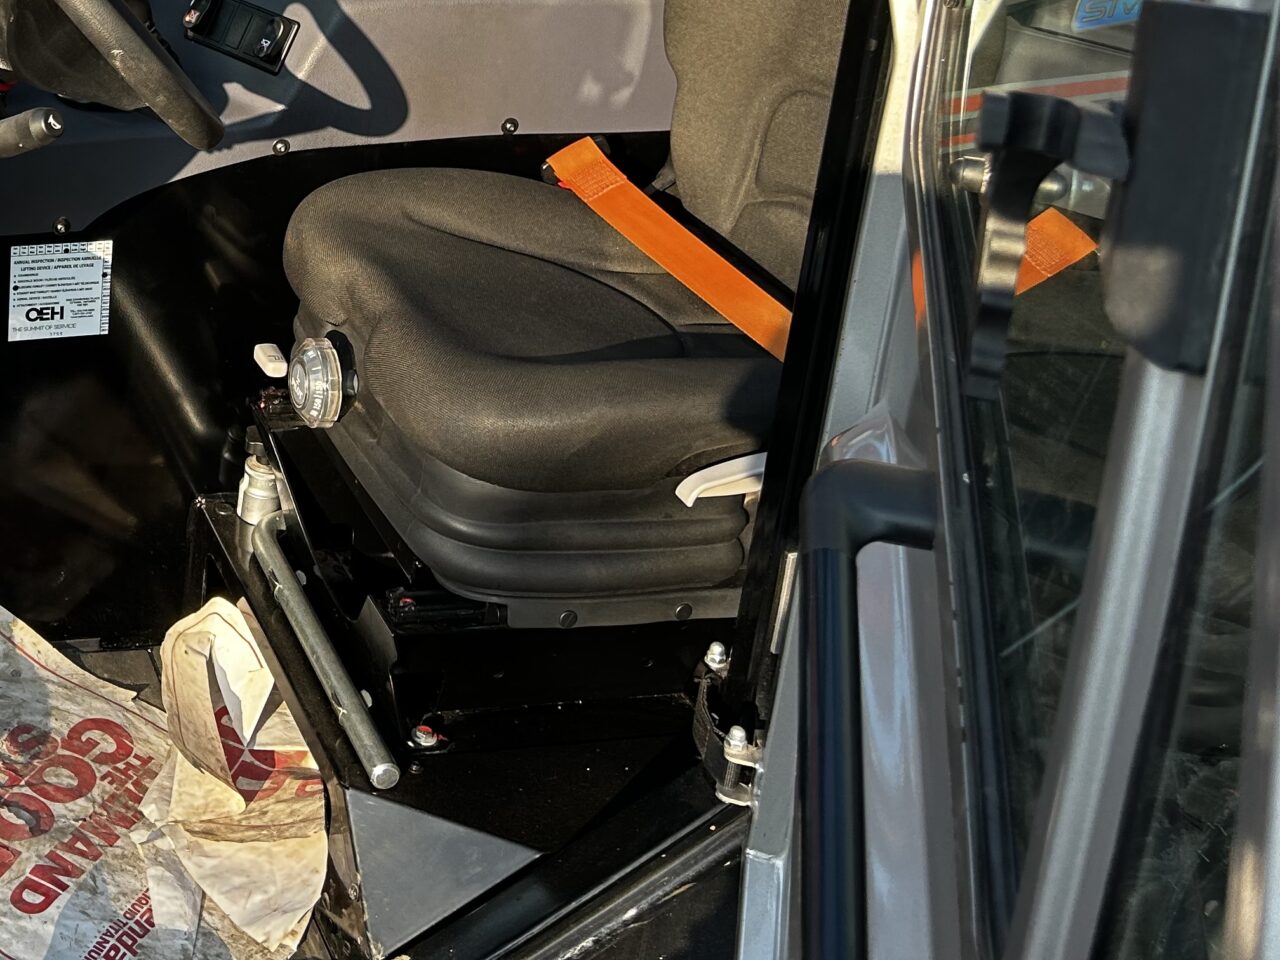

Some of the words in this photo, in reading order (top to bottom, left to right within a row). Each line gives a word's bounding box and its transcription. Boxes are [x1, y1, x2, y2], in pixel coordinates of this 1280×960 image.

[25, 305, 64, 322] OEH
[23, 325, 44, 333] SUMMIT
[54, 322, 77, 330] SERVICE
[99, 752, 154, 791] THE
